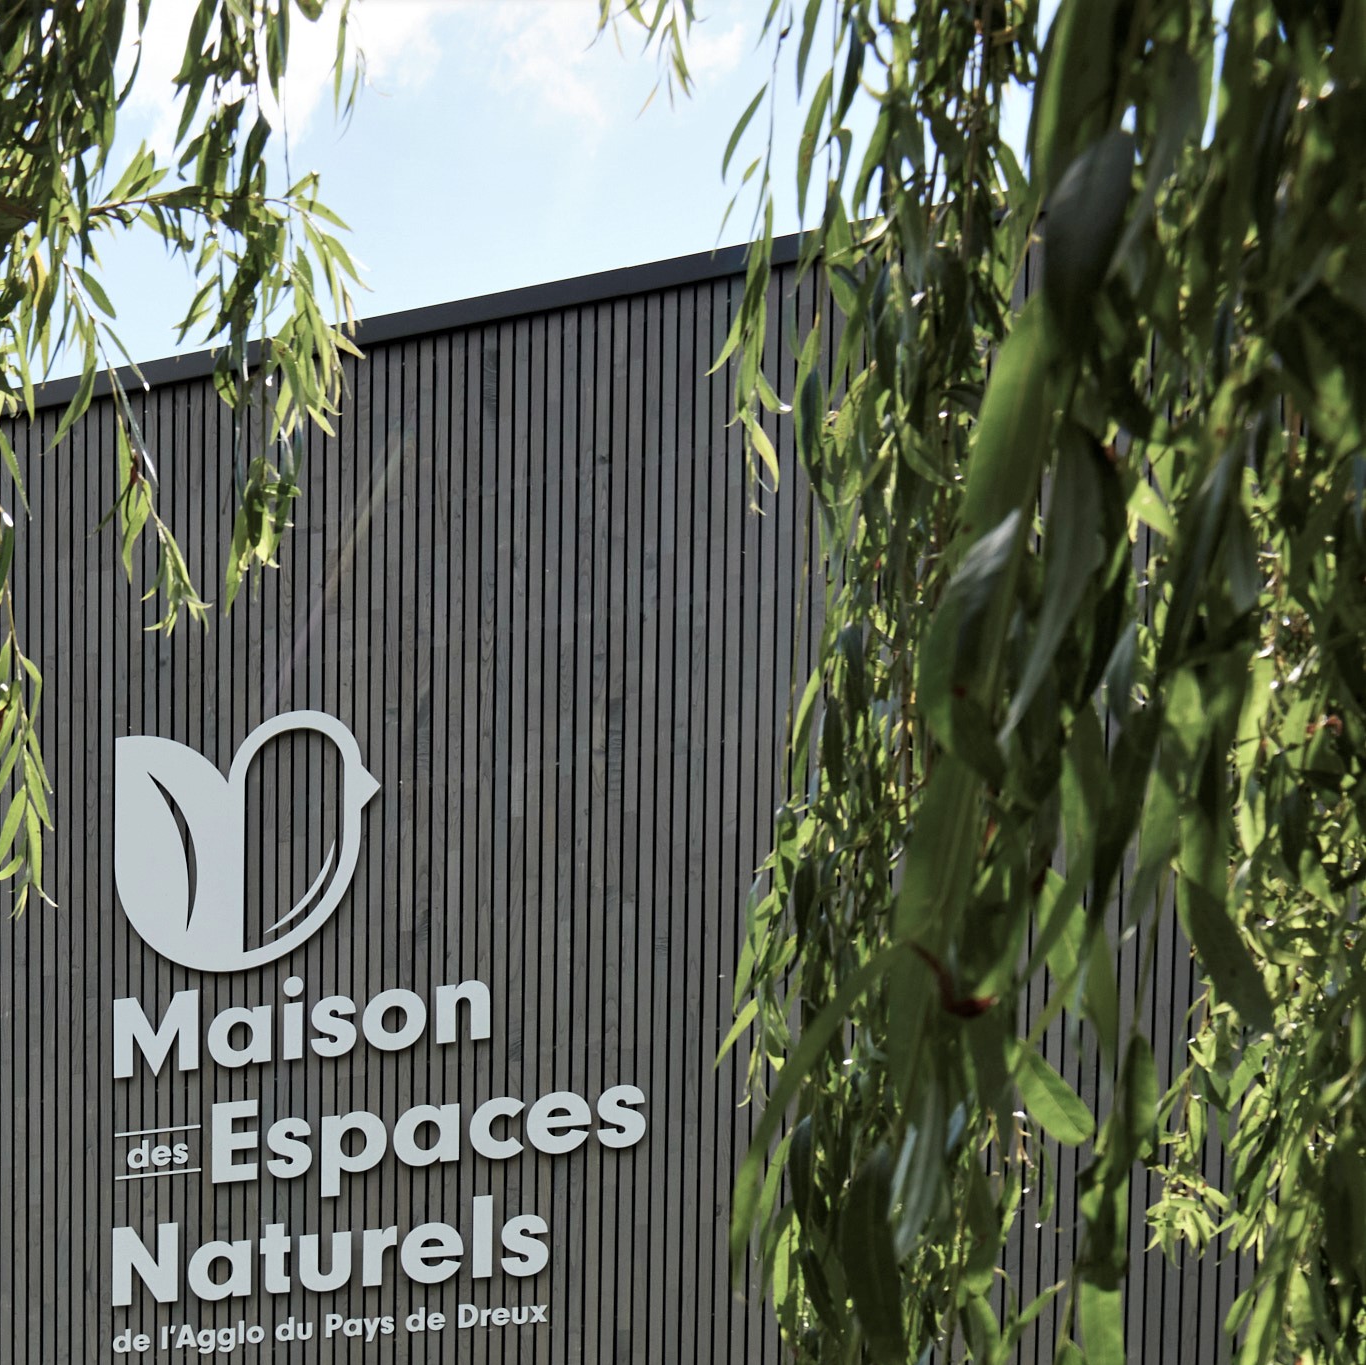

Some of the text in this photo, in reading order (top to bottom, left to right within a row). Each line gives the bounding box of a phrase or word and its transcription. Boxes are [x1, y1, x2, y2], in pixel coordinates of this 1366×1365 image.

[113, 975, 491, 1079] Maison
[127, 1084, 647, 1198] des Espaces
[112, 1194, 550, 1307] Naturels
[112, 1303, 549, 1355] de l'Agglo du Pays de Dreux
